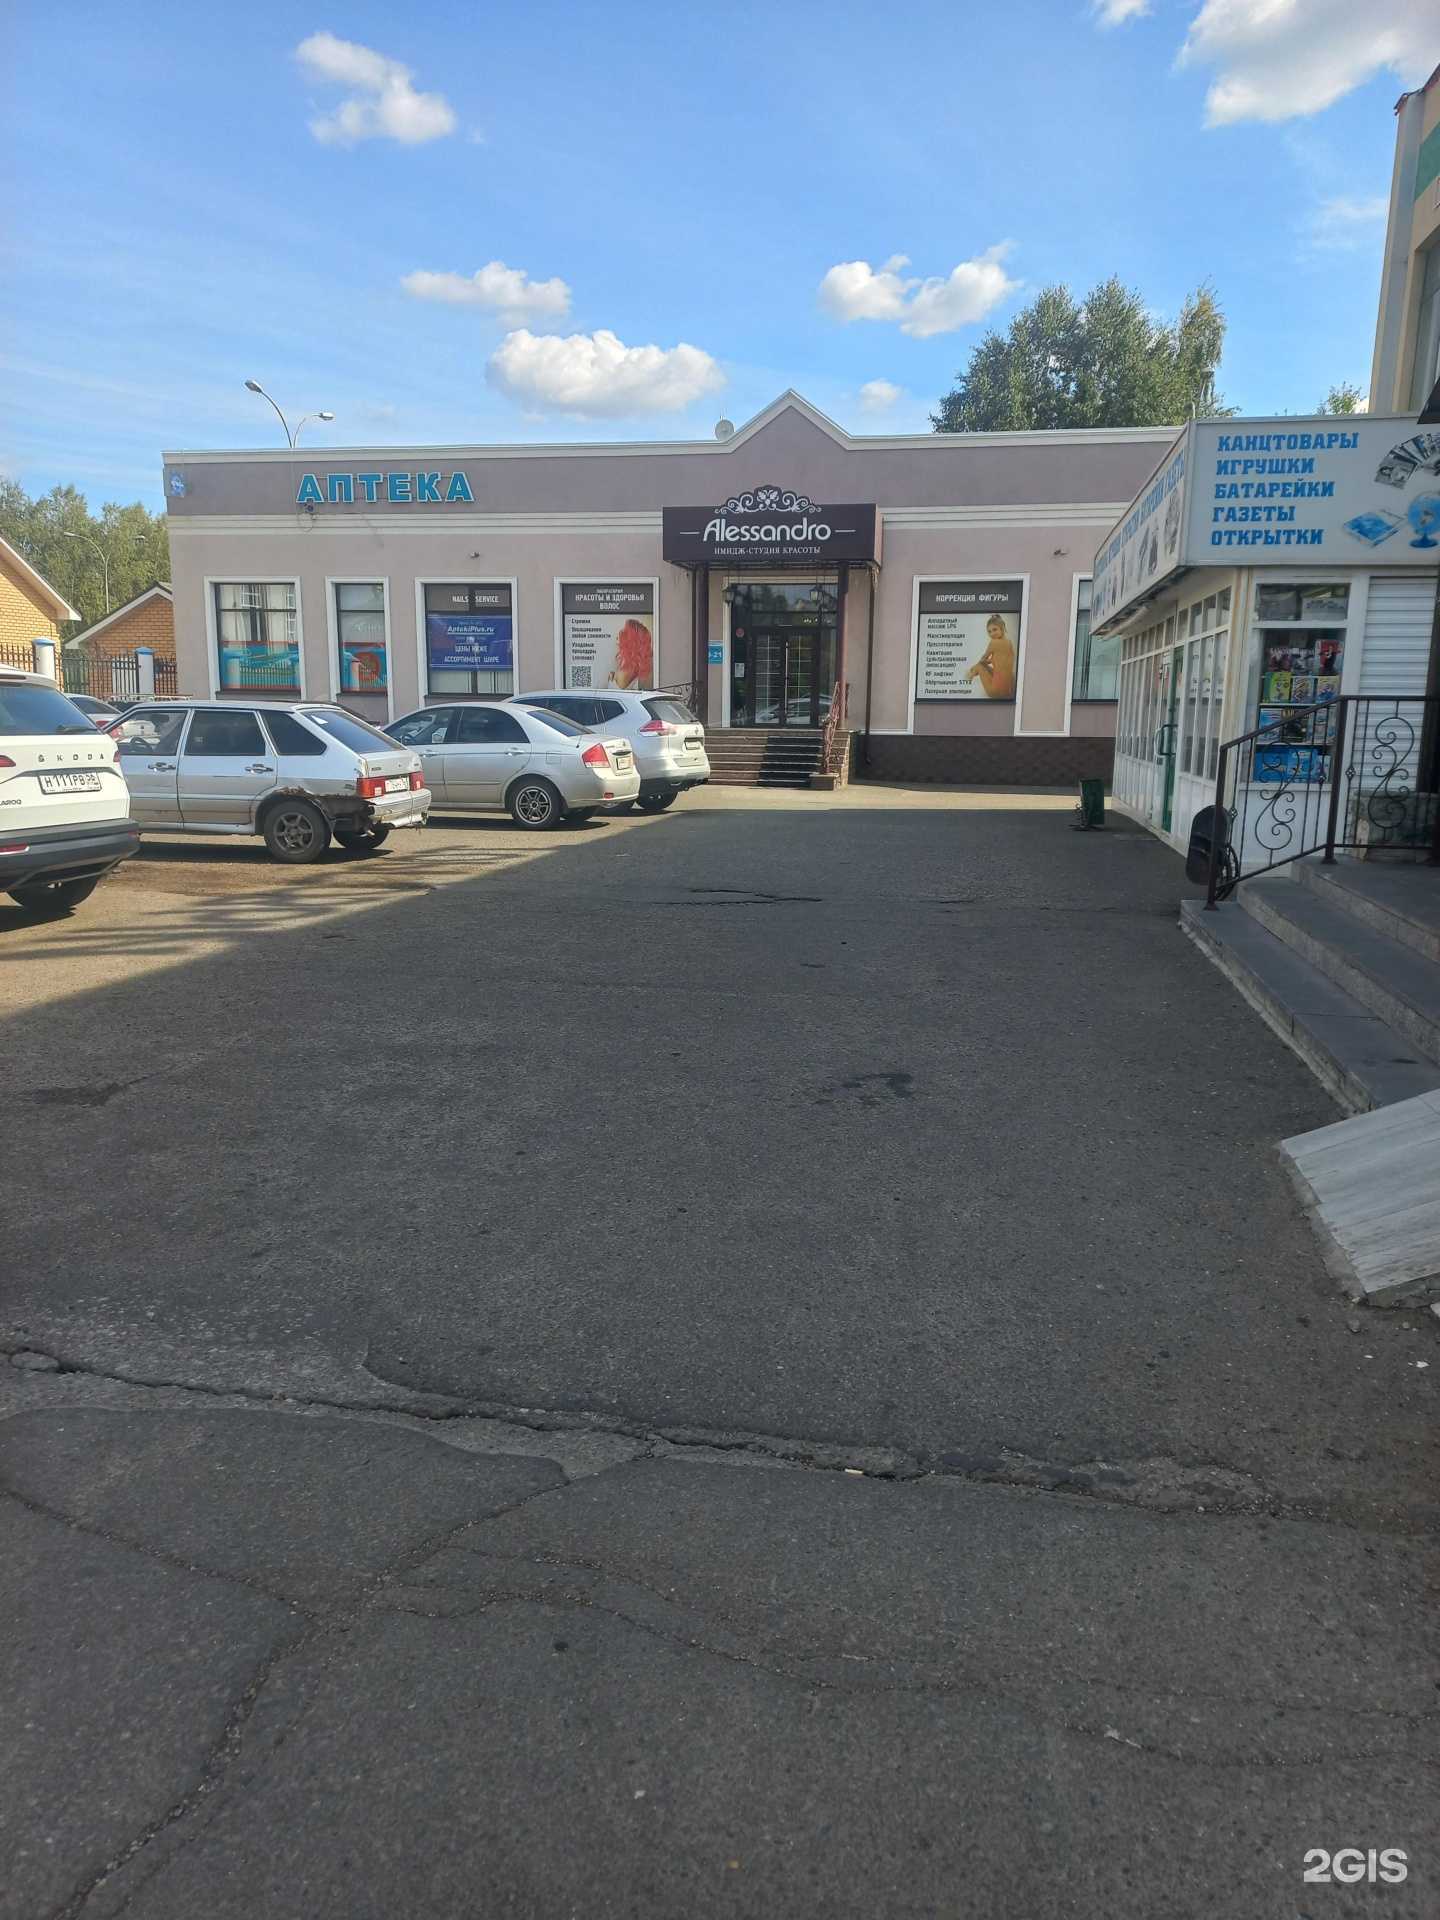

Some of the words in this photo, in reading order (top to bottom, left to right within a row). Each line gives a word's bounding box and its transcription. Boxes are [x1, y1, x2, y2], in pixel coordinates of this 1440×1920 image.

[1217, 432, 1359, 451] КАНЦТОВАРЫ
[1216, 457, 1315, 475] ИГРУШКИ
[296, 472, 474, 503] АПТЕКА
[1214, 478, 1335, 499] БАТАРЕЙКИ
[1212, 506, 1296, 522] ГАЗЕТЫ
[703, 517, 831, 541] Alessandro
[1211, 529, 1324, 545] ОТКРЫТКИ
[714, 547, 780, 555] ИМИДЖ-СТУДИЯ
